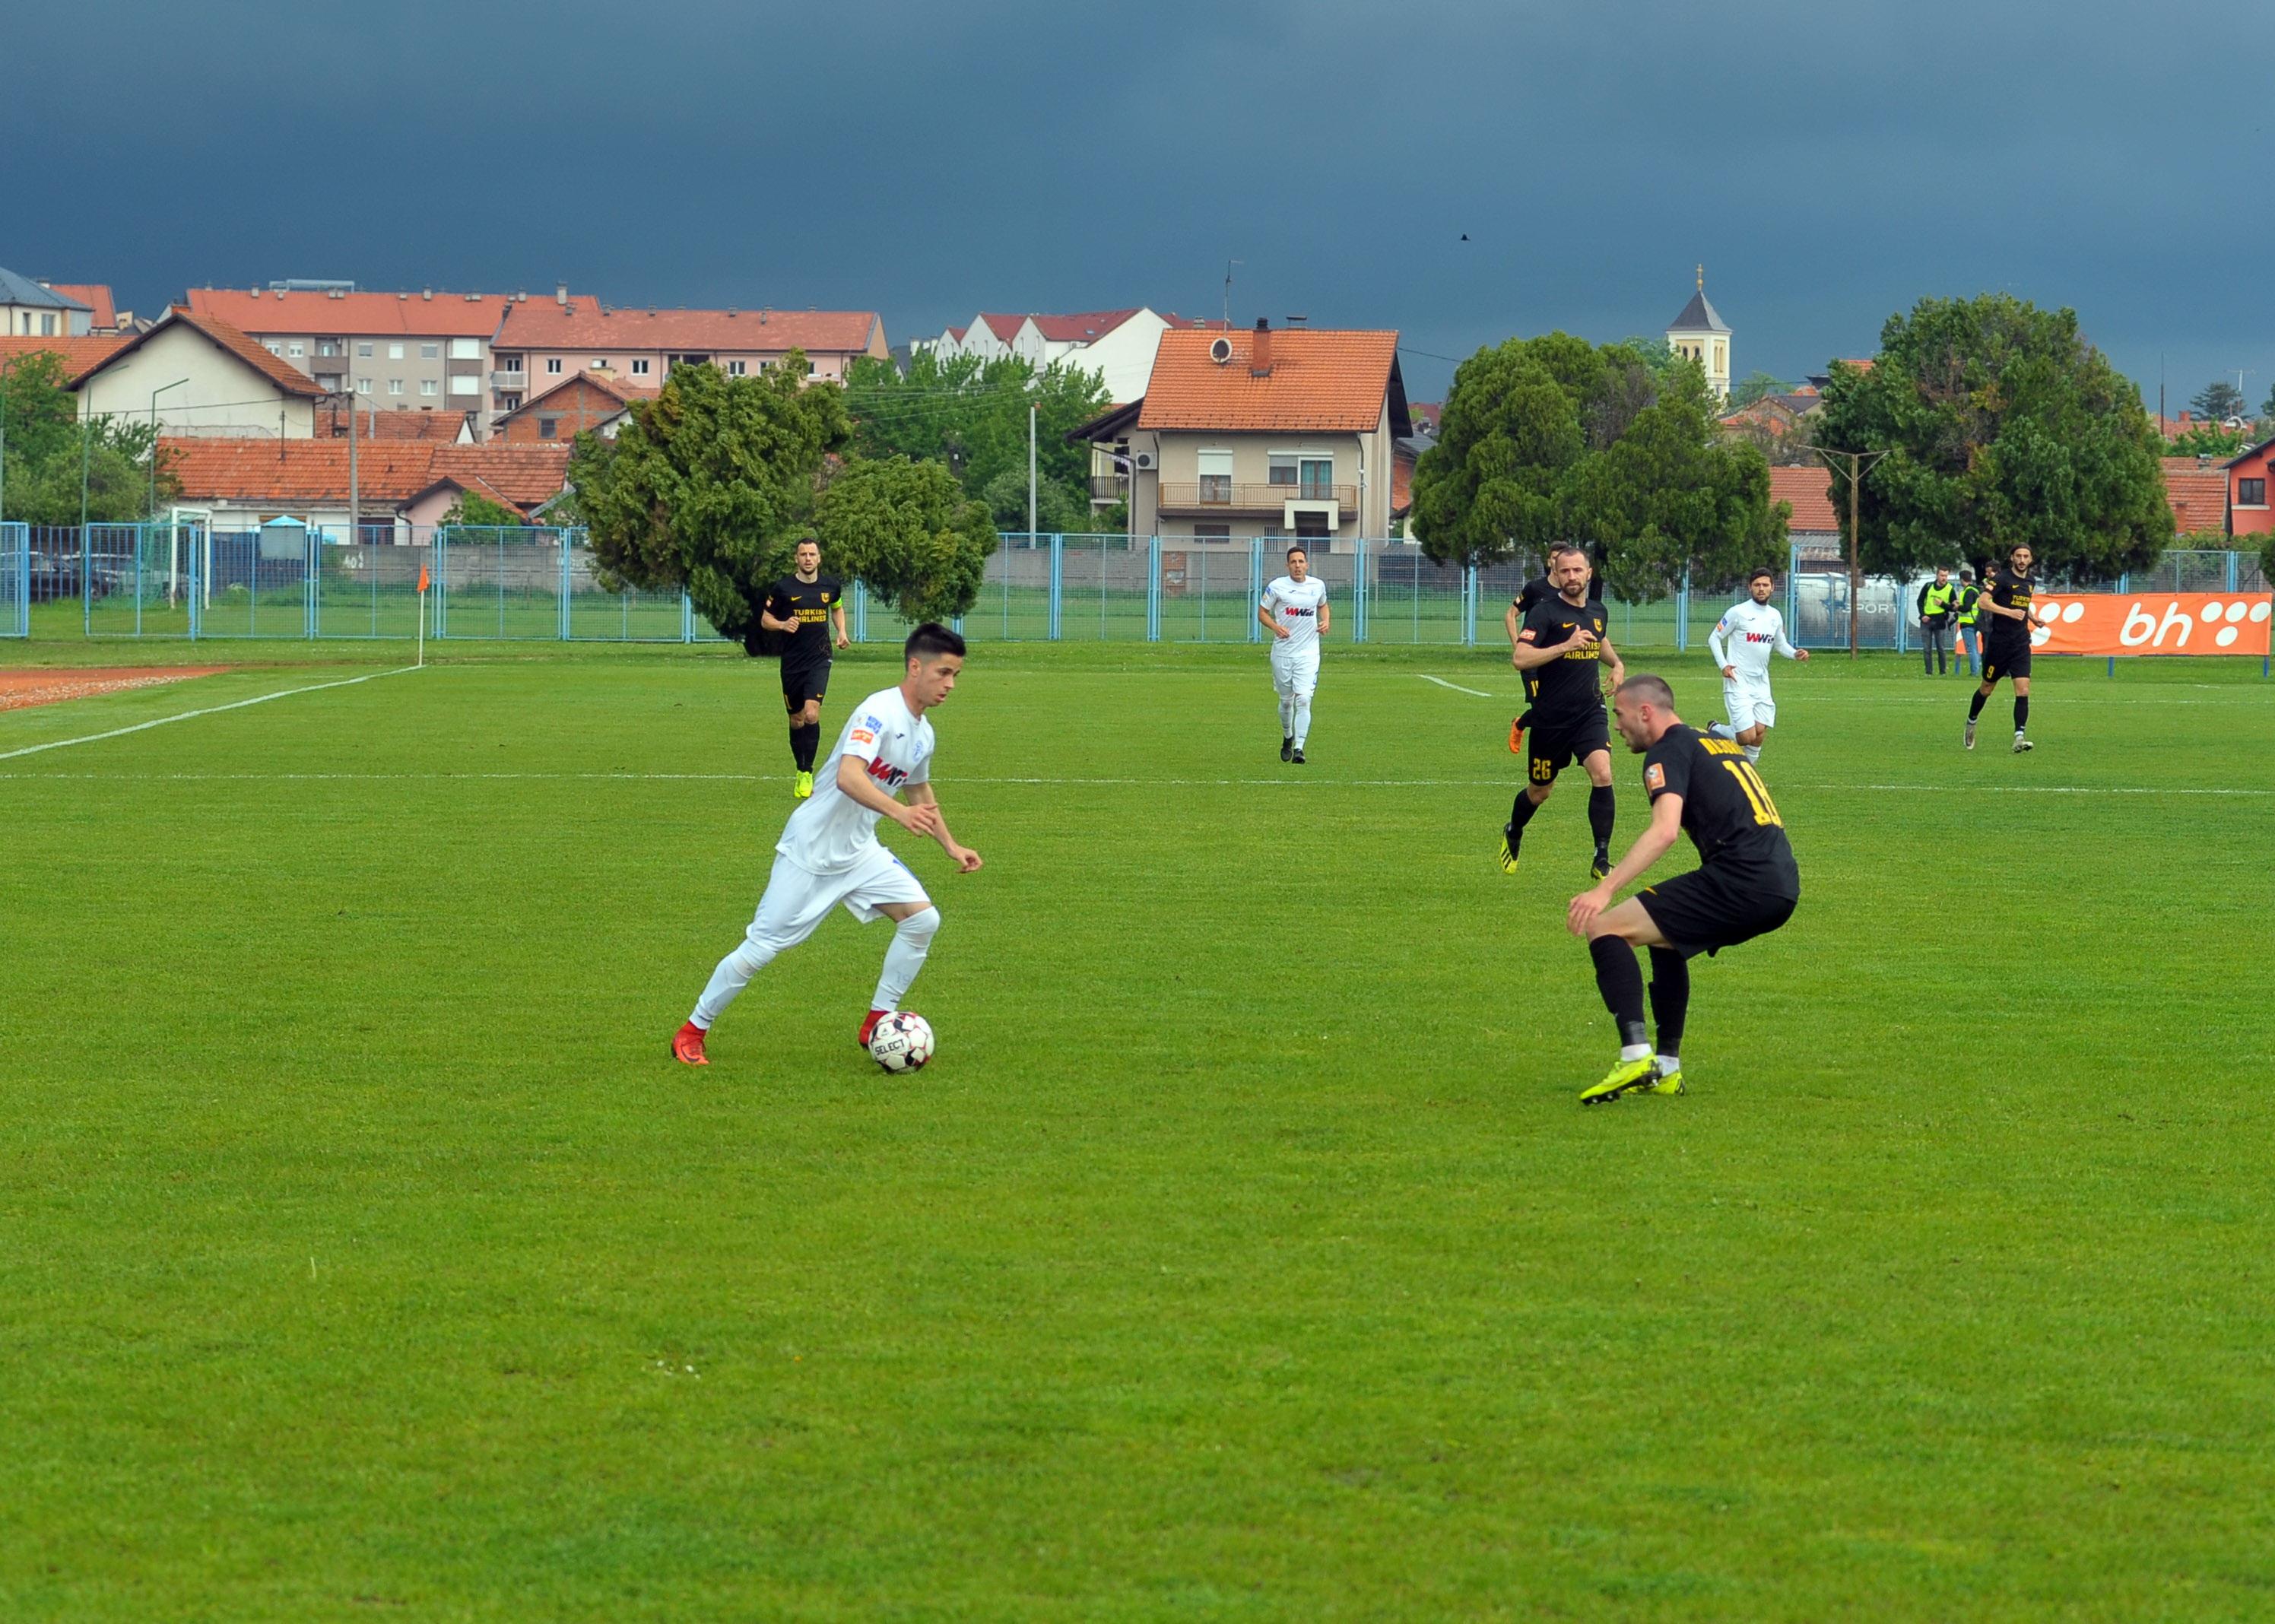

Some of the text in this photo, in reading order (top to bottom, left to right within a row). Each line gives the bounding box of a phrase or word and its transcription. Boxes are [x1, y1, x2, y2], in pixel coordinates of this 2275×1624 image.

[2119, 601, 2193, 647] bh
[1987, 665, 1994, 678] 9
[1533, 758, 1551, 780] 26
[874, 1039, 905, 1056] SELECT
